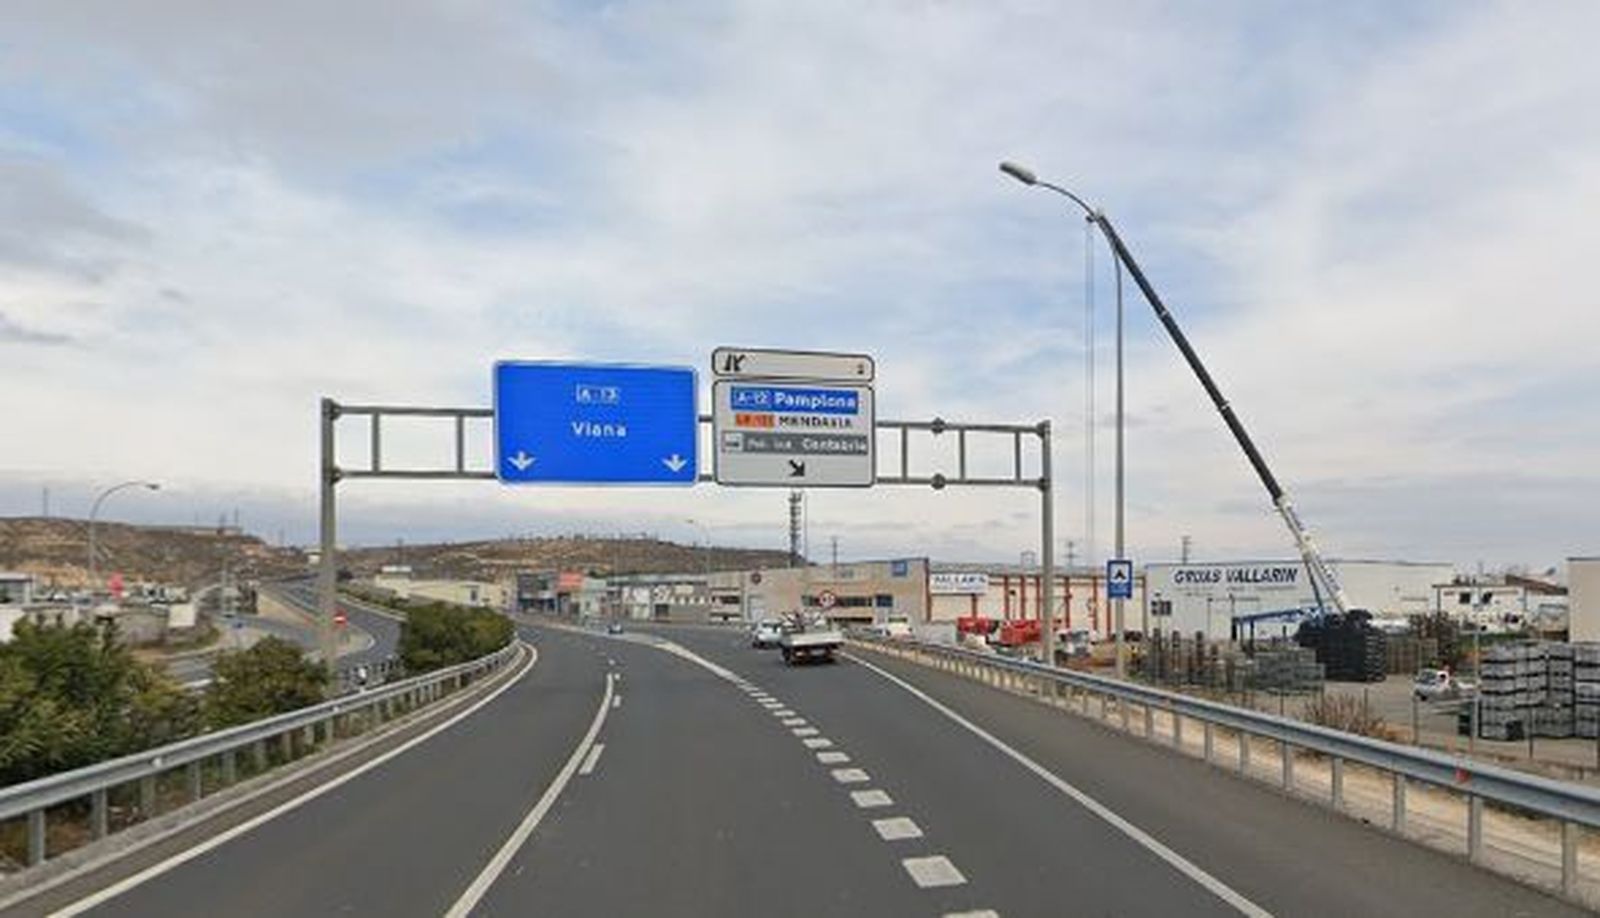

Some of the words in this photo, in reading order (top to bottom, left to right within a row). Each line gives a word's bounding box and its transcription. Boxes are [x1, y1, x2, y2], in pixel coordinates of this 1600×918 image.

[775, 391, 855, 409] Pamplona
[571, 421, 626, 437] Viana
[1173, 570, 1221, 584] GRUAS
[1226, 568, 1298, 583] VALLARIN
